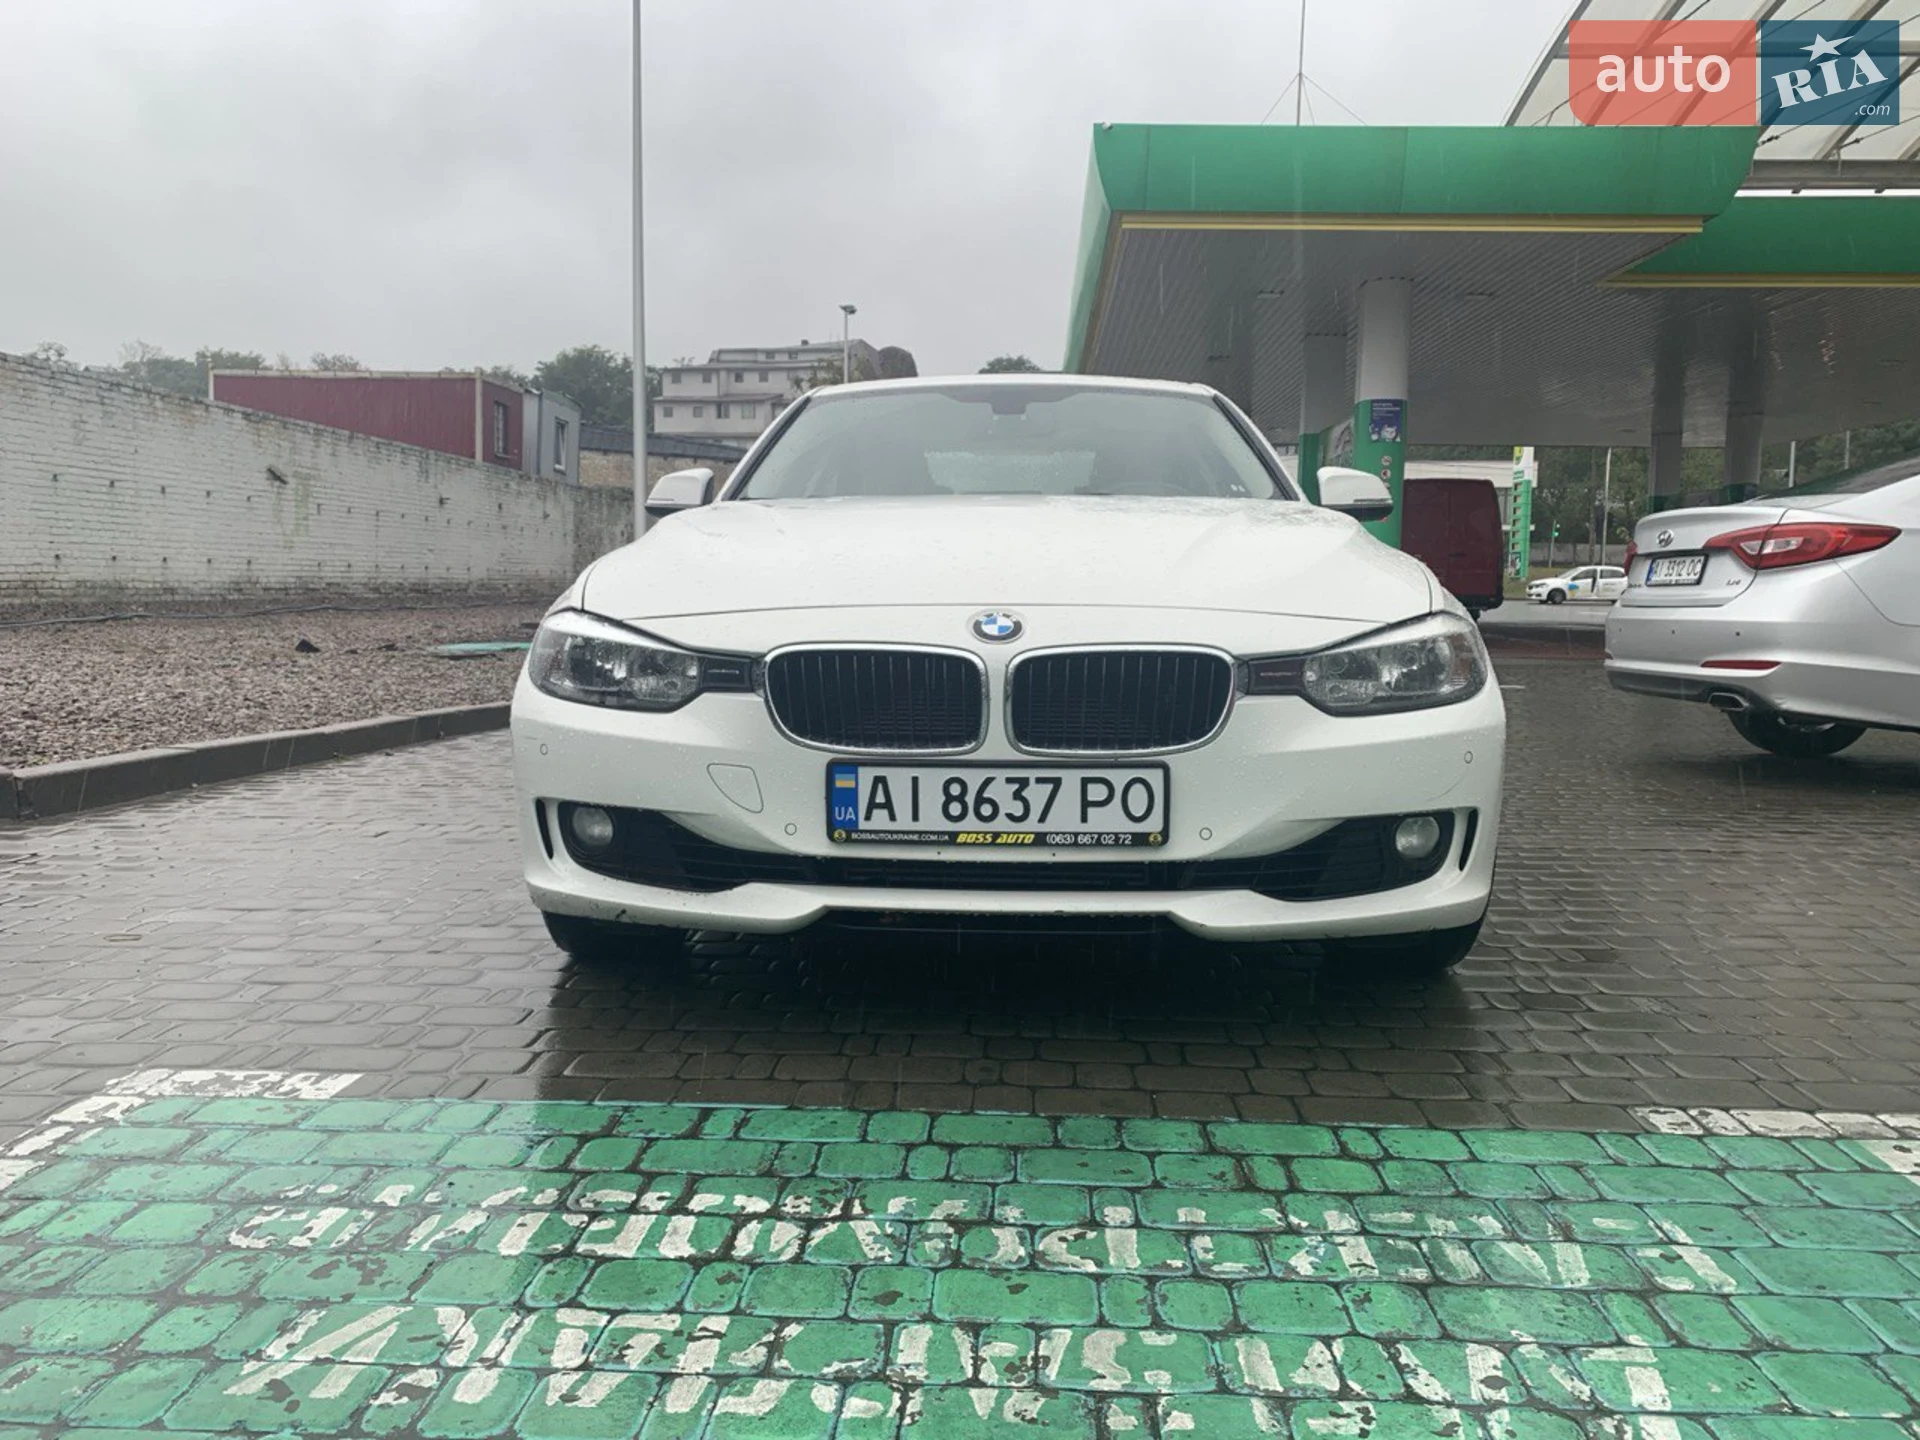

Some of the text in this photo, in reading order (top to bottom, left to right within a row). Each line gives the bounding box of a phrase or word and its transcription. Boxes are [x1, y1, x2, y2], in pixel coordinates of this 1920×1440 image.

[863, 775, 1156, 824] AI 8637 PO
[834, 806, 856, 821] UA
[851, 831, 949, 842] BOSSAUTOUKRAINE.COM.UA
[956, 832, 1035, 845] BOSS AUTO
[1046, 834, 1132, 845] (063) 667 02 72
